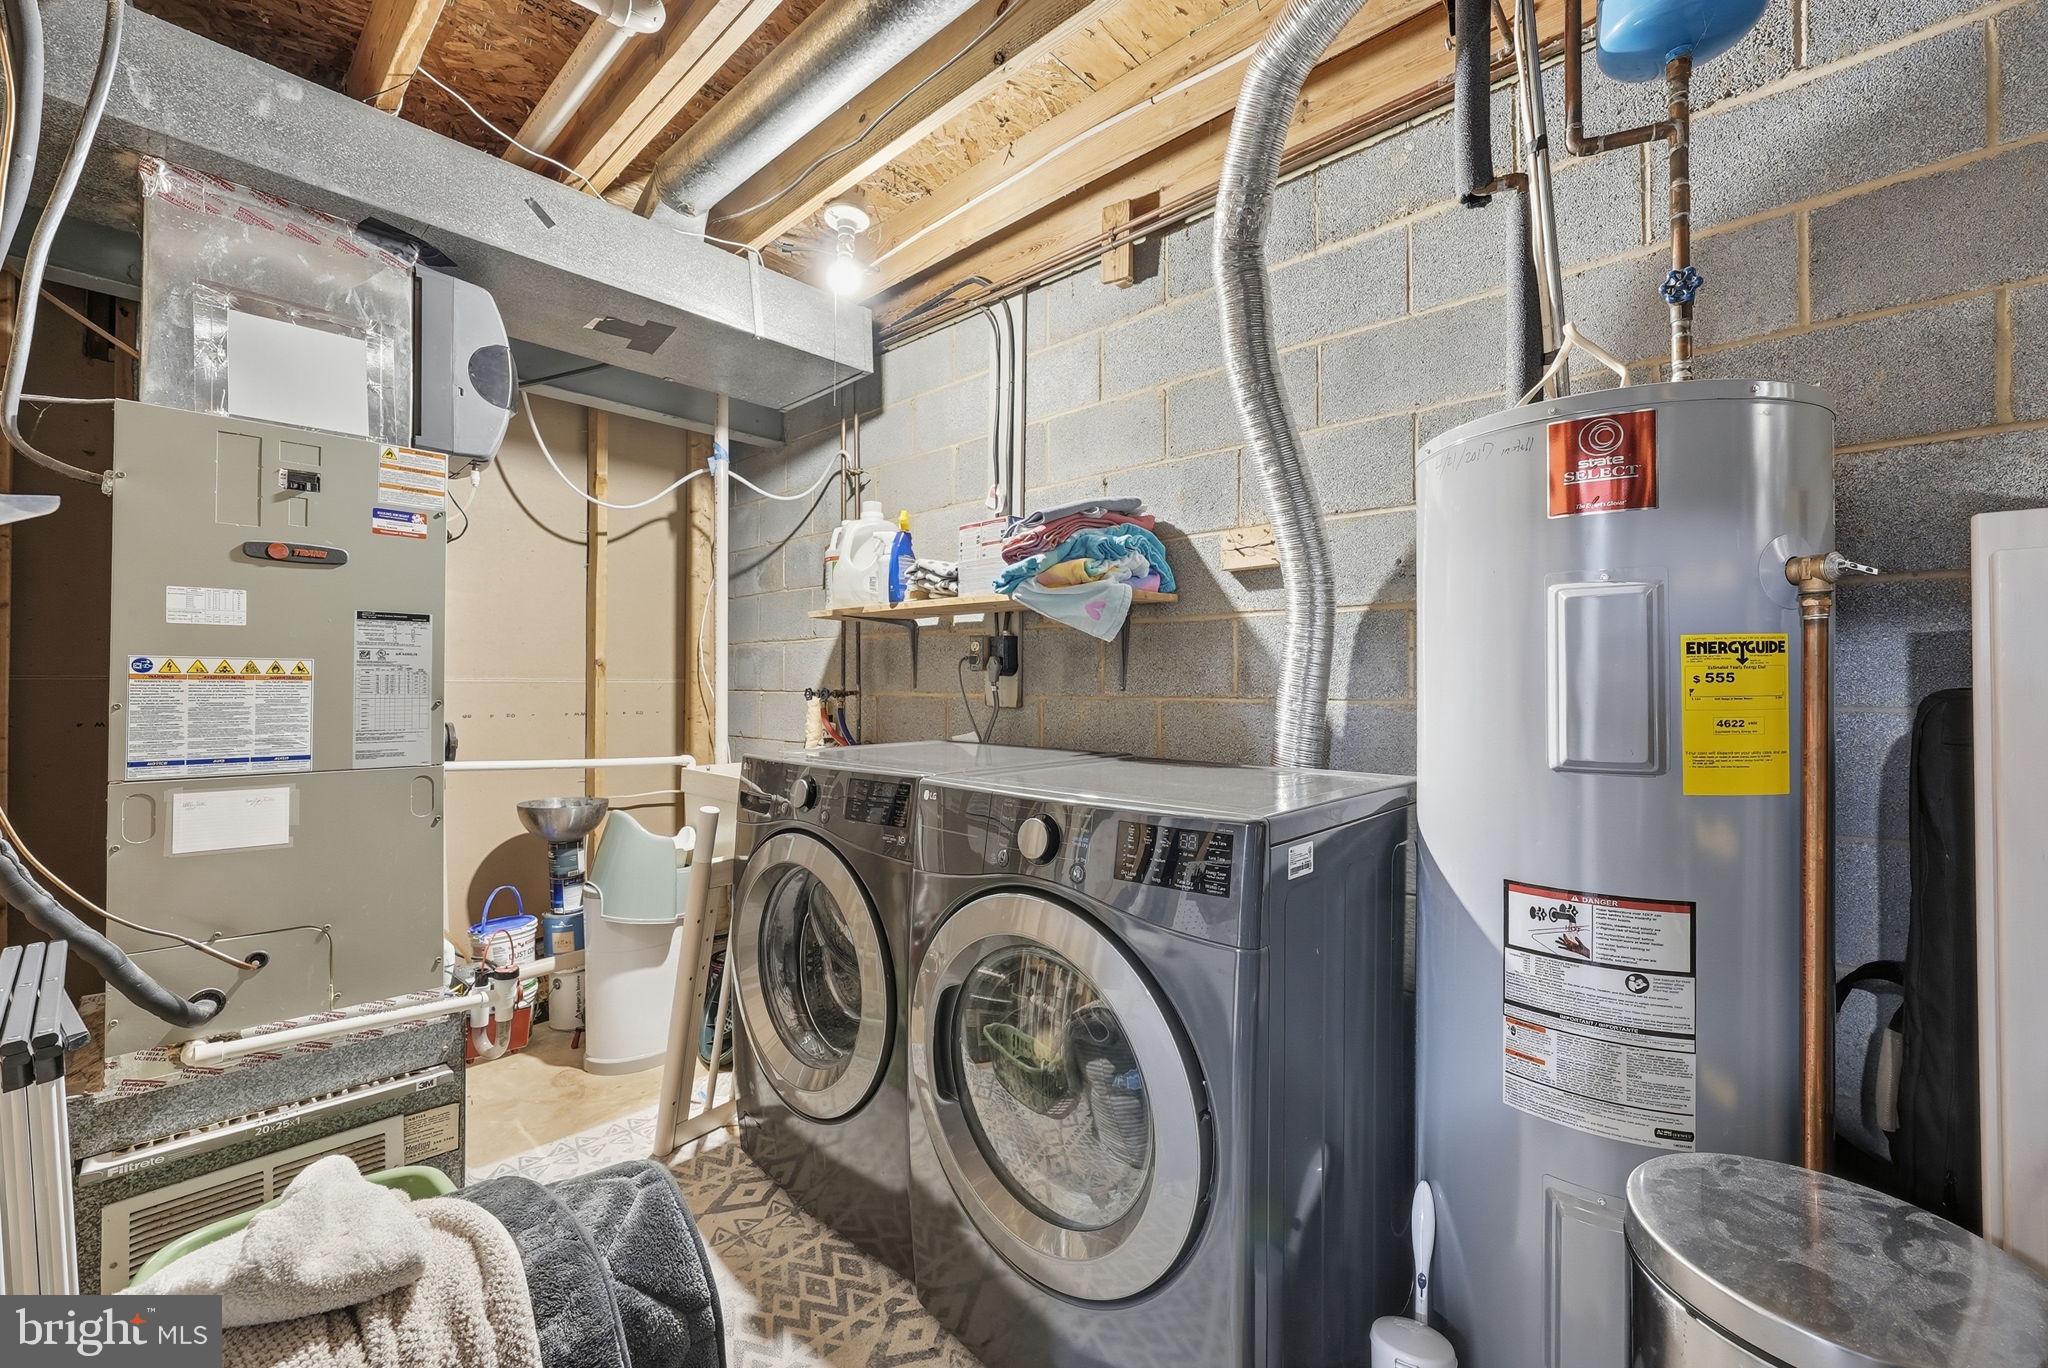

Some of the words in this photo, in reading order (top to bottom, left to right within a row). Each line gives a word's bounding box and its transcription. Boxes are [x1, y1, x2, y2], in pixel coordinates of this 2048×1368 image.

[1578, 455, 1624, 469] state
[1564, 465, 1639, 482] SELECT
[1686, 641, 1785, 655] ENERGYGUIDE
[1693, 675, 1701, 684] $
[1705, 672, 1735, 683] 555
[1716, 719, 1745, 728] 4622
[930, 792, 937, 800] LG
[1582, 897, 1618, 907] DANGER
[418, 1079, 434, 1090] 3M
[255, 1116, 300, 1137] 20x25x1
[107, 1156, 165, 1178] Filtrete
